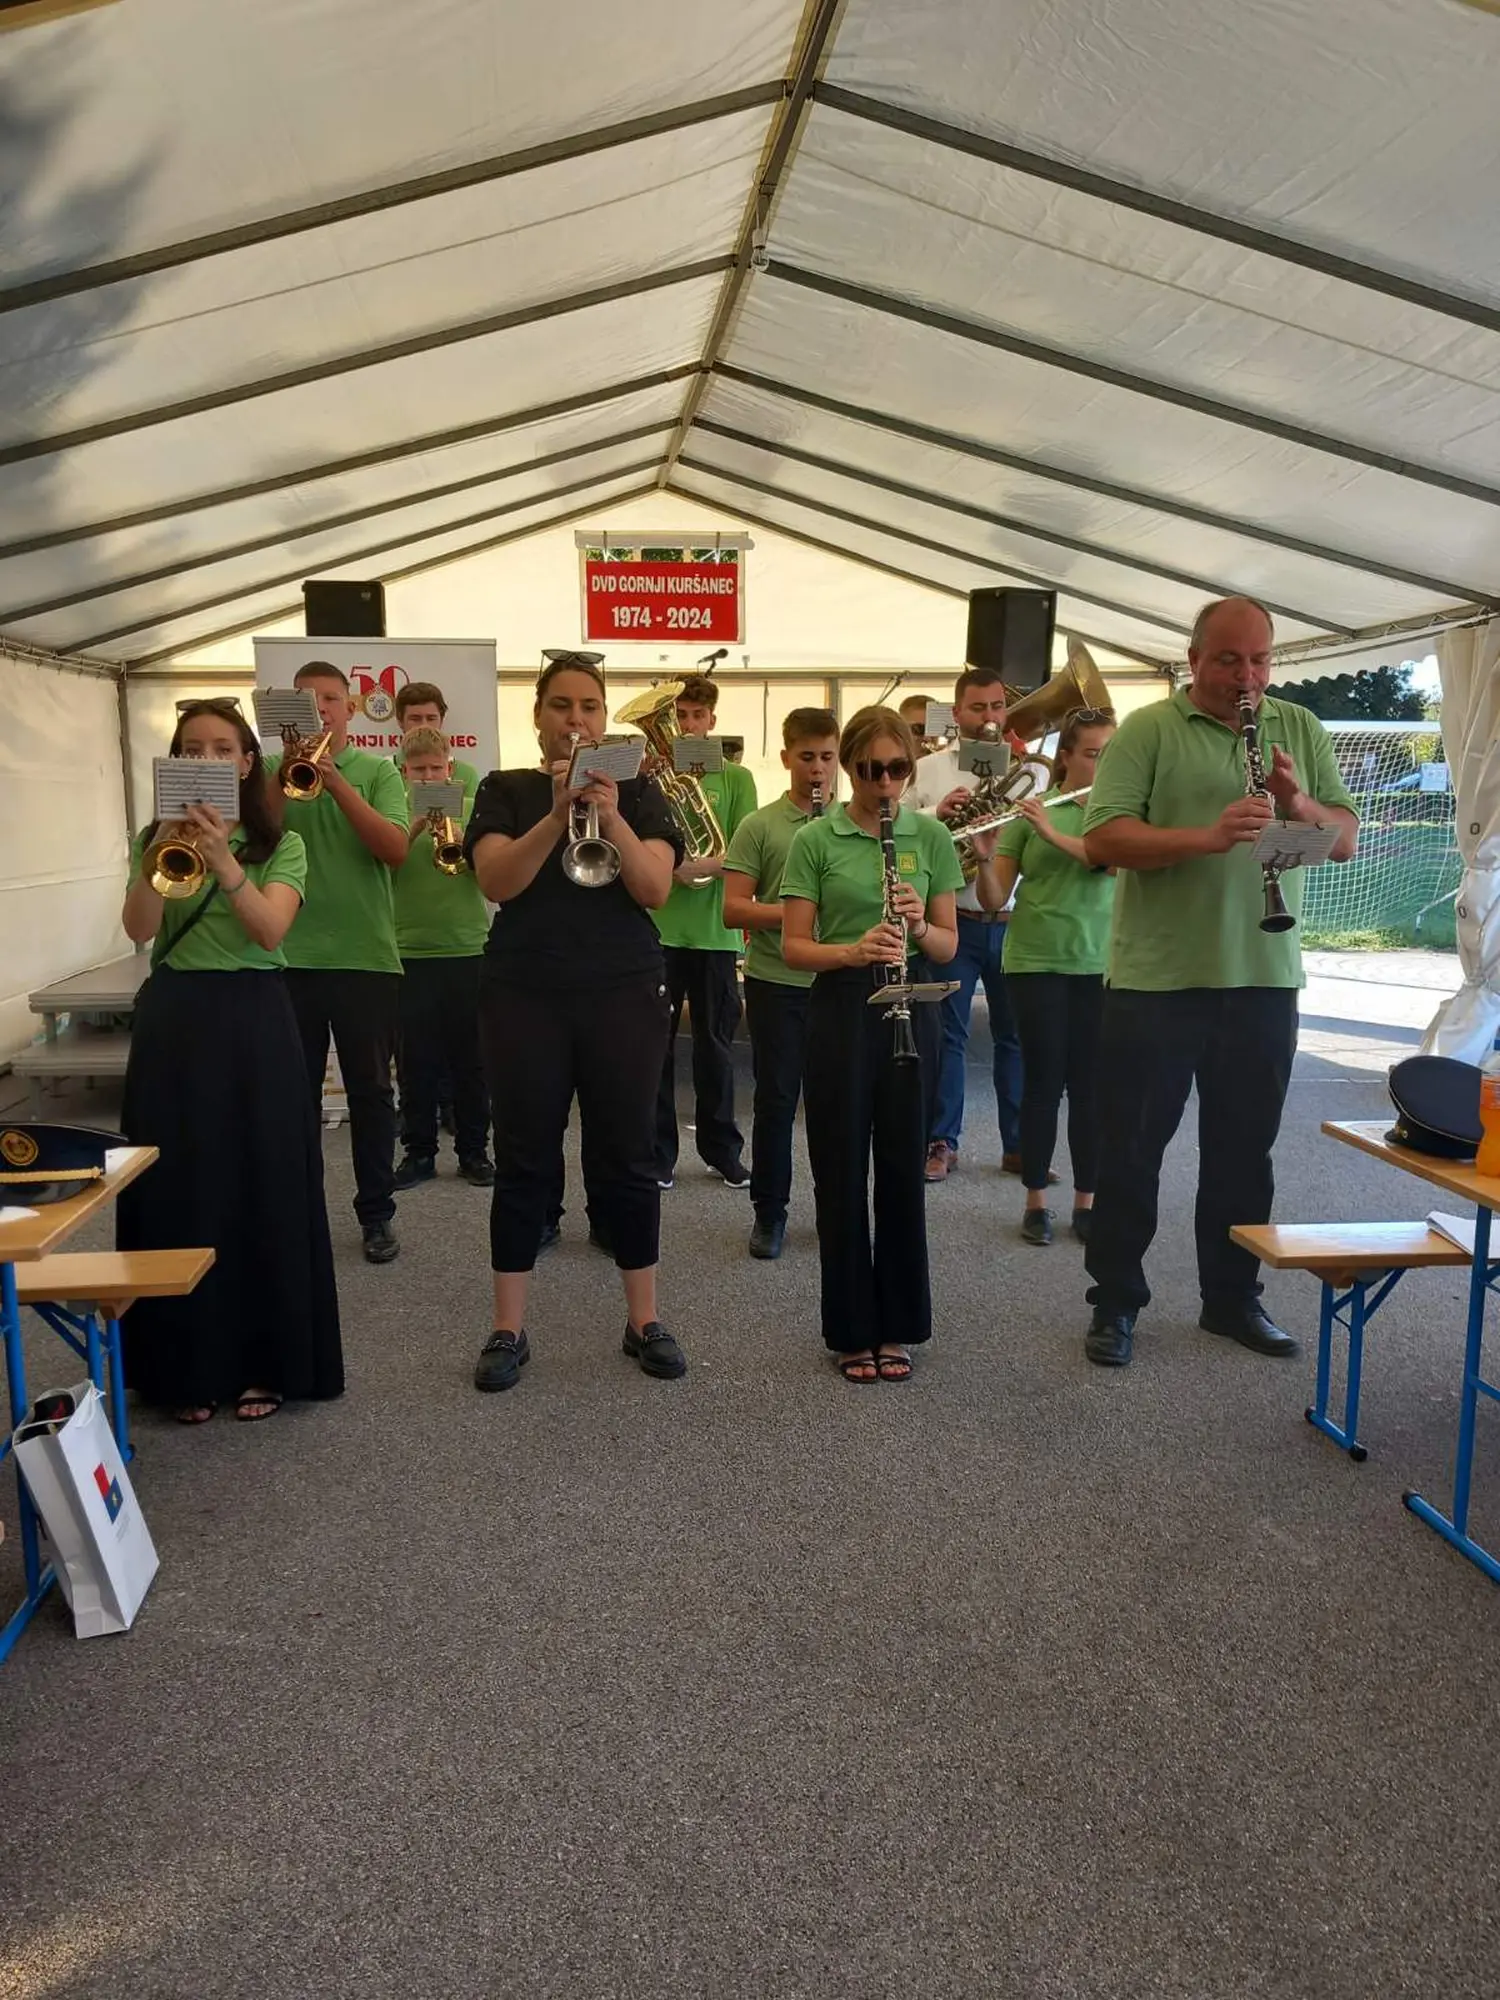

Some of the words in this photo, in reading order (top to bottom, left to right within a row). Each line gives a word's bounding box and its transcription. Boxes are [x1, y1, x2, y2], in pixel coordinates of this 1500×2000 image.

[591, 575, 617, 592] DVD
[619, 575, 665, 593] GORNJI
[667, 574, 734, 594] KURŠANEC
[611, 606, 652, 628] 1974
[667, 607, 713, 629] 2024
[347, 734, 384, 748] RNJI
